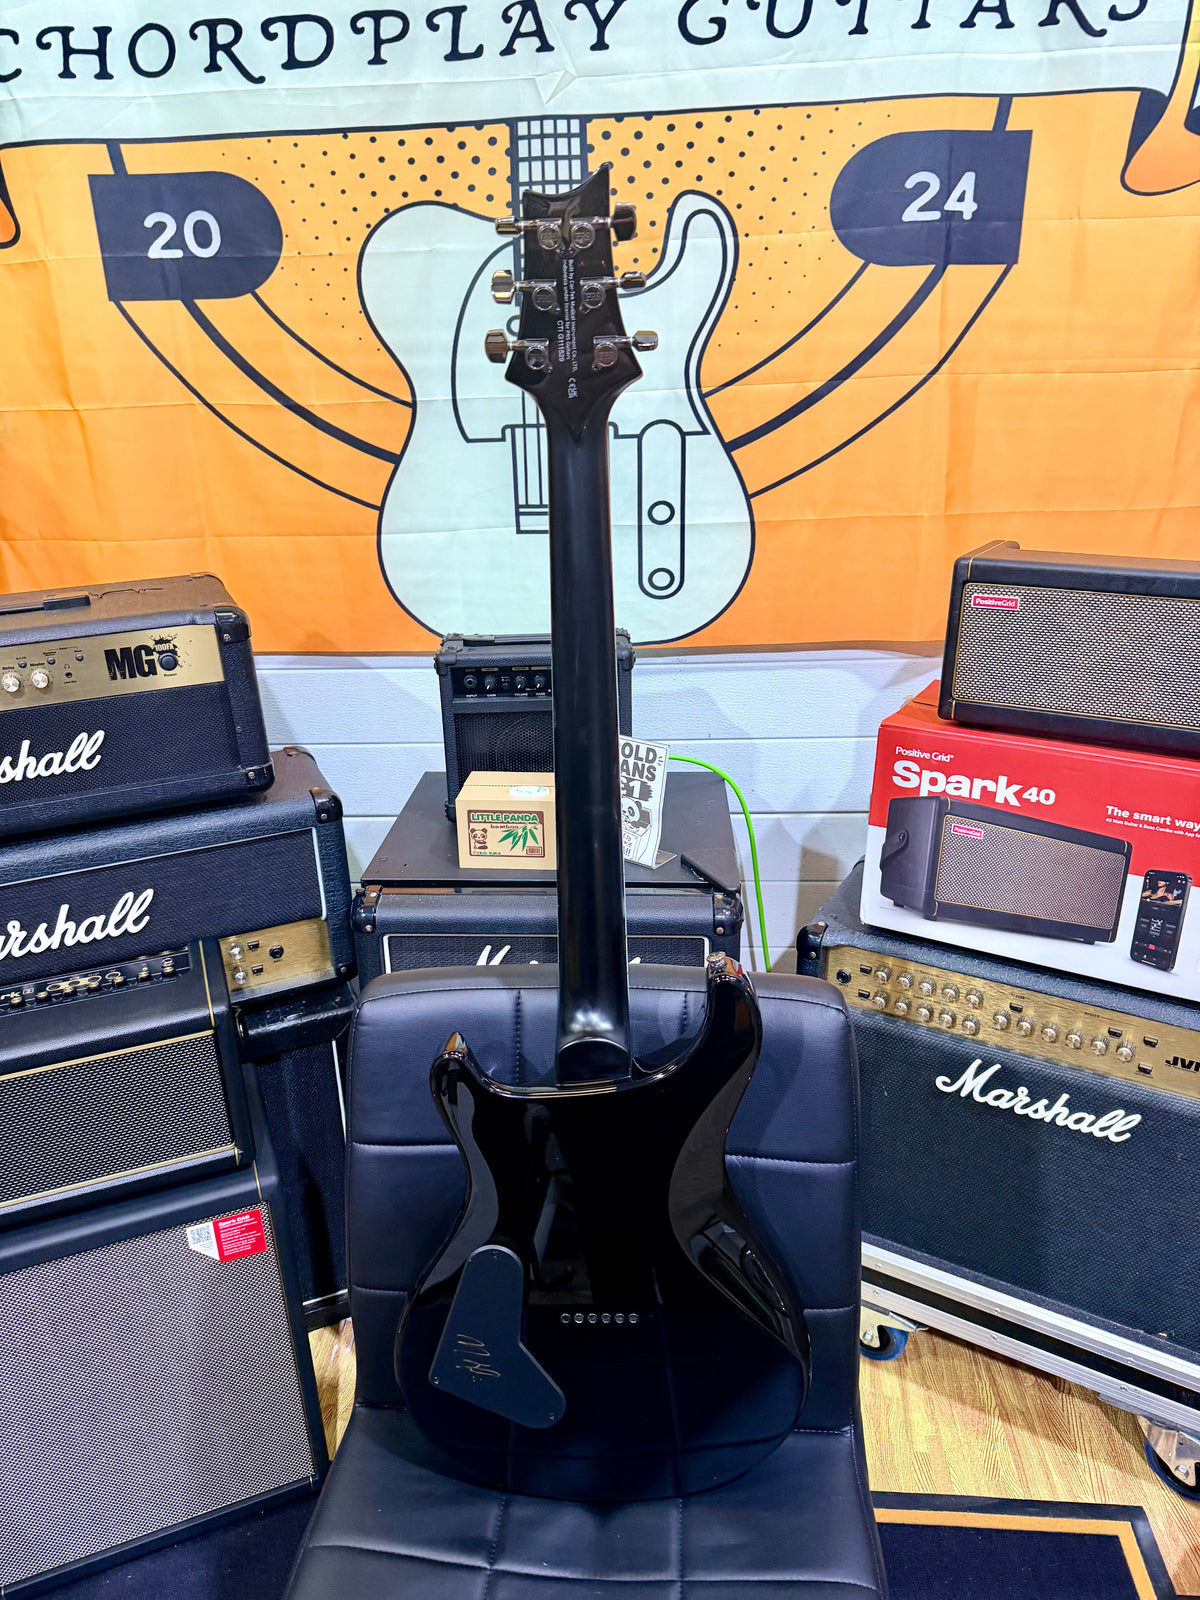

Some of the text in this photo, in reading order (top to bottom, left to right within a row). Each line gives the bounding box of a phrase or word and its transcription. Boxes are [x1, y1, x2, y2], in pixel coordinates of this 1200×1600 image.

[901, 170, 978, 223] 24
[144, 209, 221, 260] 20
[104, 644, 158, 682] MG
[0, 729, 105, 784] shall
[620, 742, 658, 764] OLD
[620, 759, 657, 782] ANS
[895, 746, 930, 760] Positive
[891, 760, 1056, 807] Spark 40
[471, 812, 539, 822] LITTLE PANDA
[1105, 805, 1200, 832] The smart way
[0, 888, 154, 961] rshall
[935, 1058, 1142, 1143] Marshall
